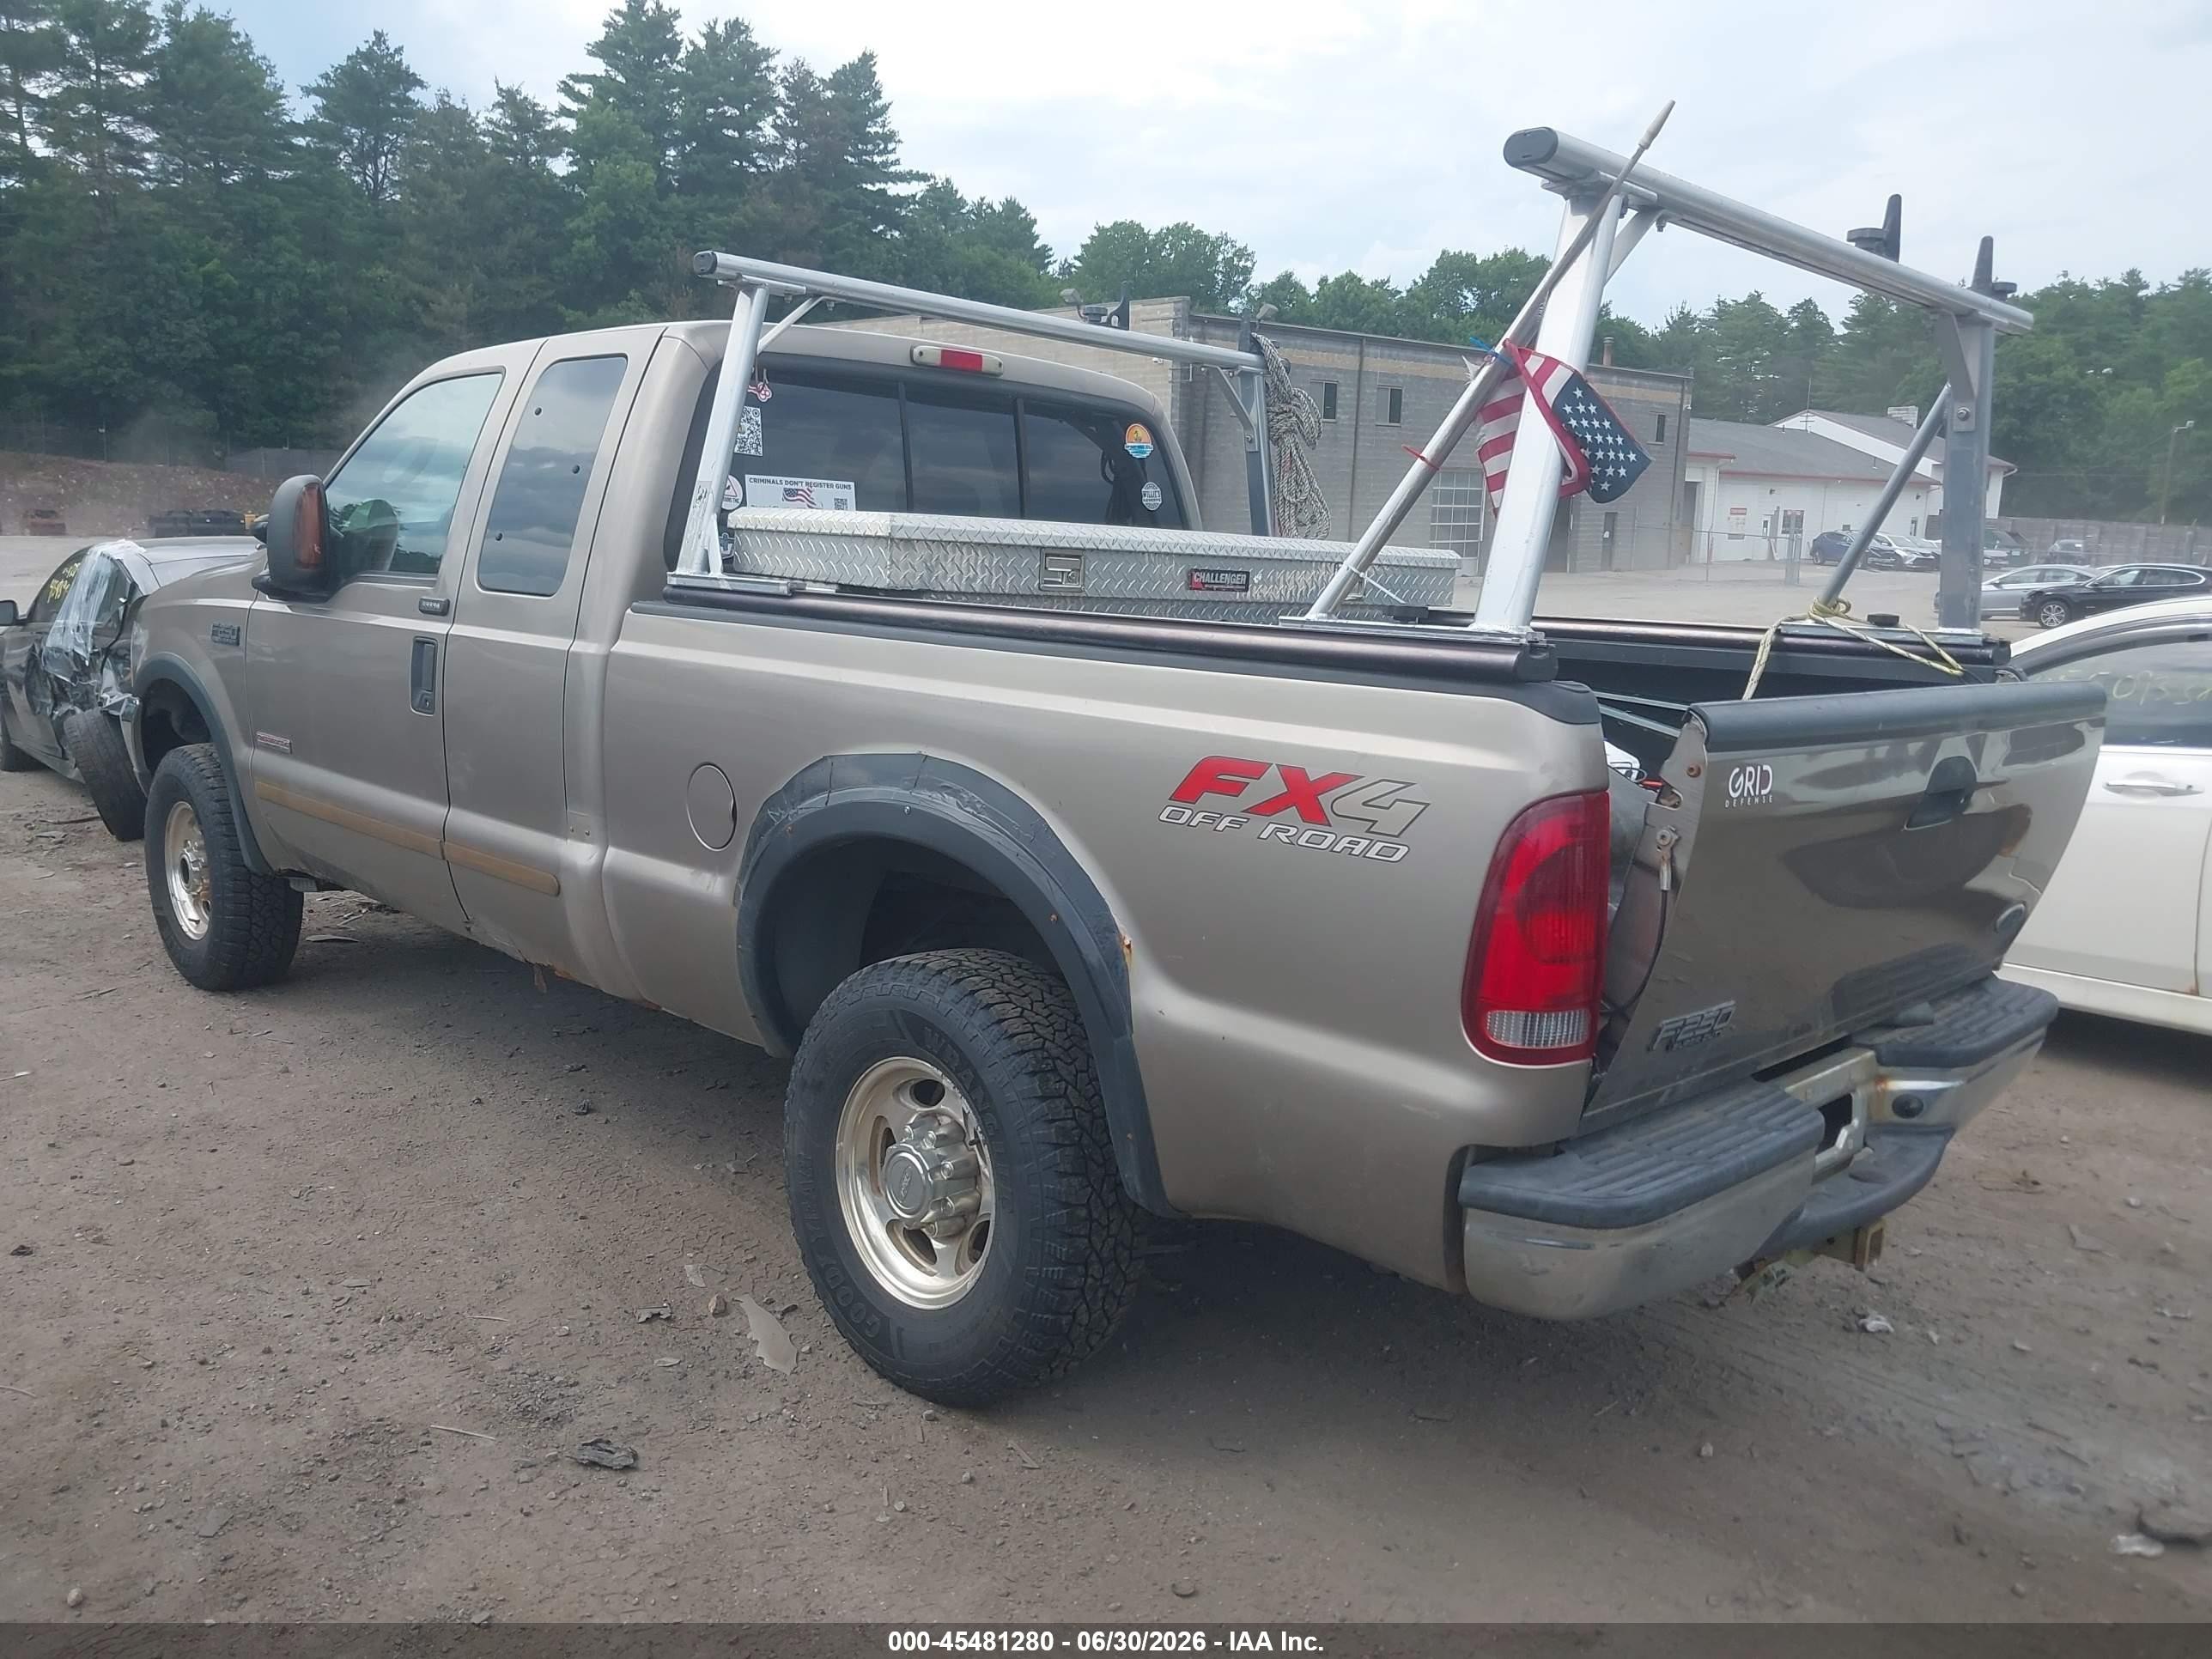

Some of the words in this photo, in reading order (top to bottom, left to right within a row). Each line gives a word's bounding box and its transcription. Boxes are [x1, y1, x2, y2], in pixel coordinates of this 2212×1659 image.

[749, 477, 783, 486] CRIMINALS
[784, 479, 804, 488] DON'T
[805, 481, 835, 489] REGISTER
[1194, 571, 1247, 585] CHALLENGER
[1168, 756, 1431, 837] FX4
[1729, 764, 1773, 798] GRID
[1725, 795, 1772, 808] DEFENSE
[1158, 805, 1250, 832] OFF
[1257, 822, 1410, 863] ROAD
[1649, 1001, 1736, 1050] F250
